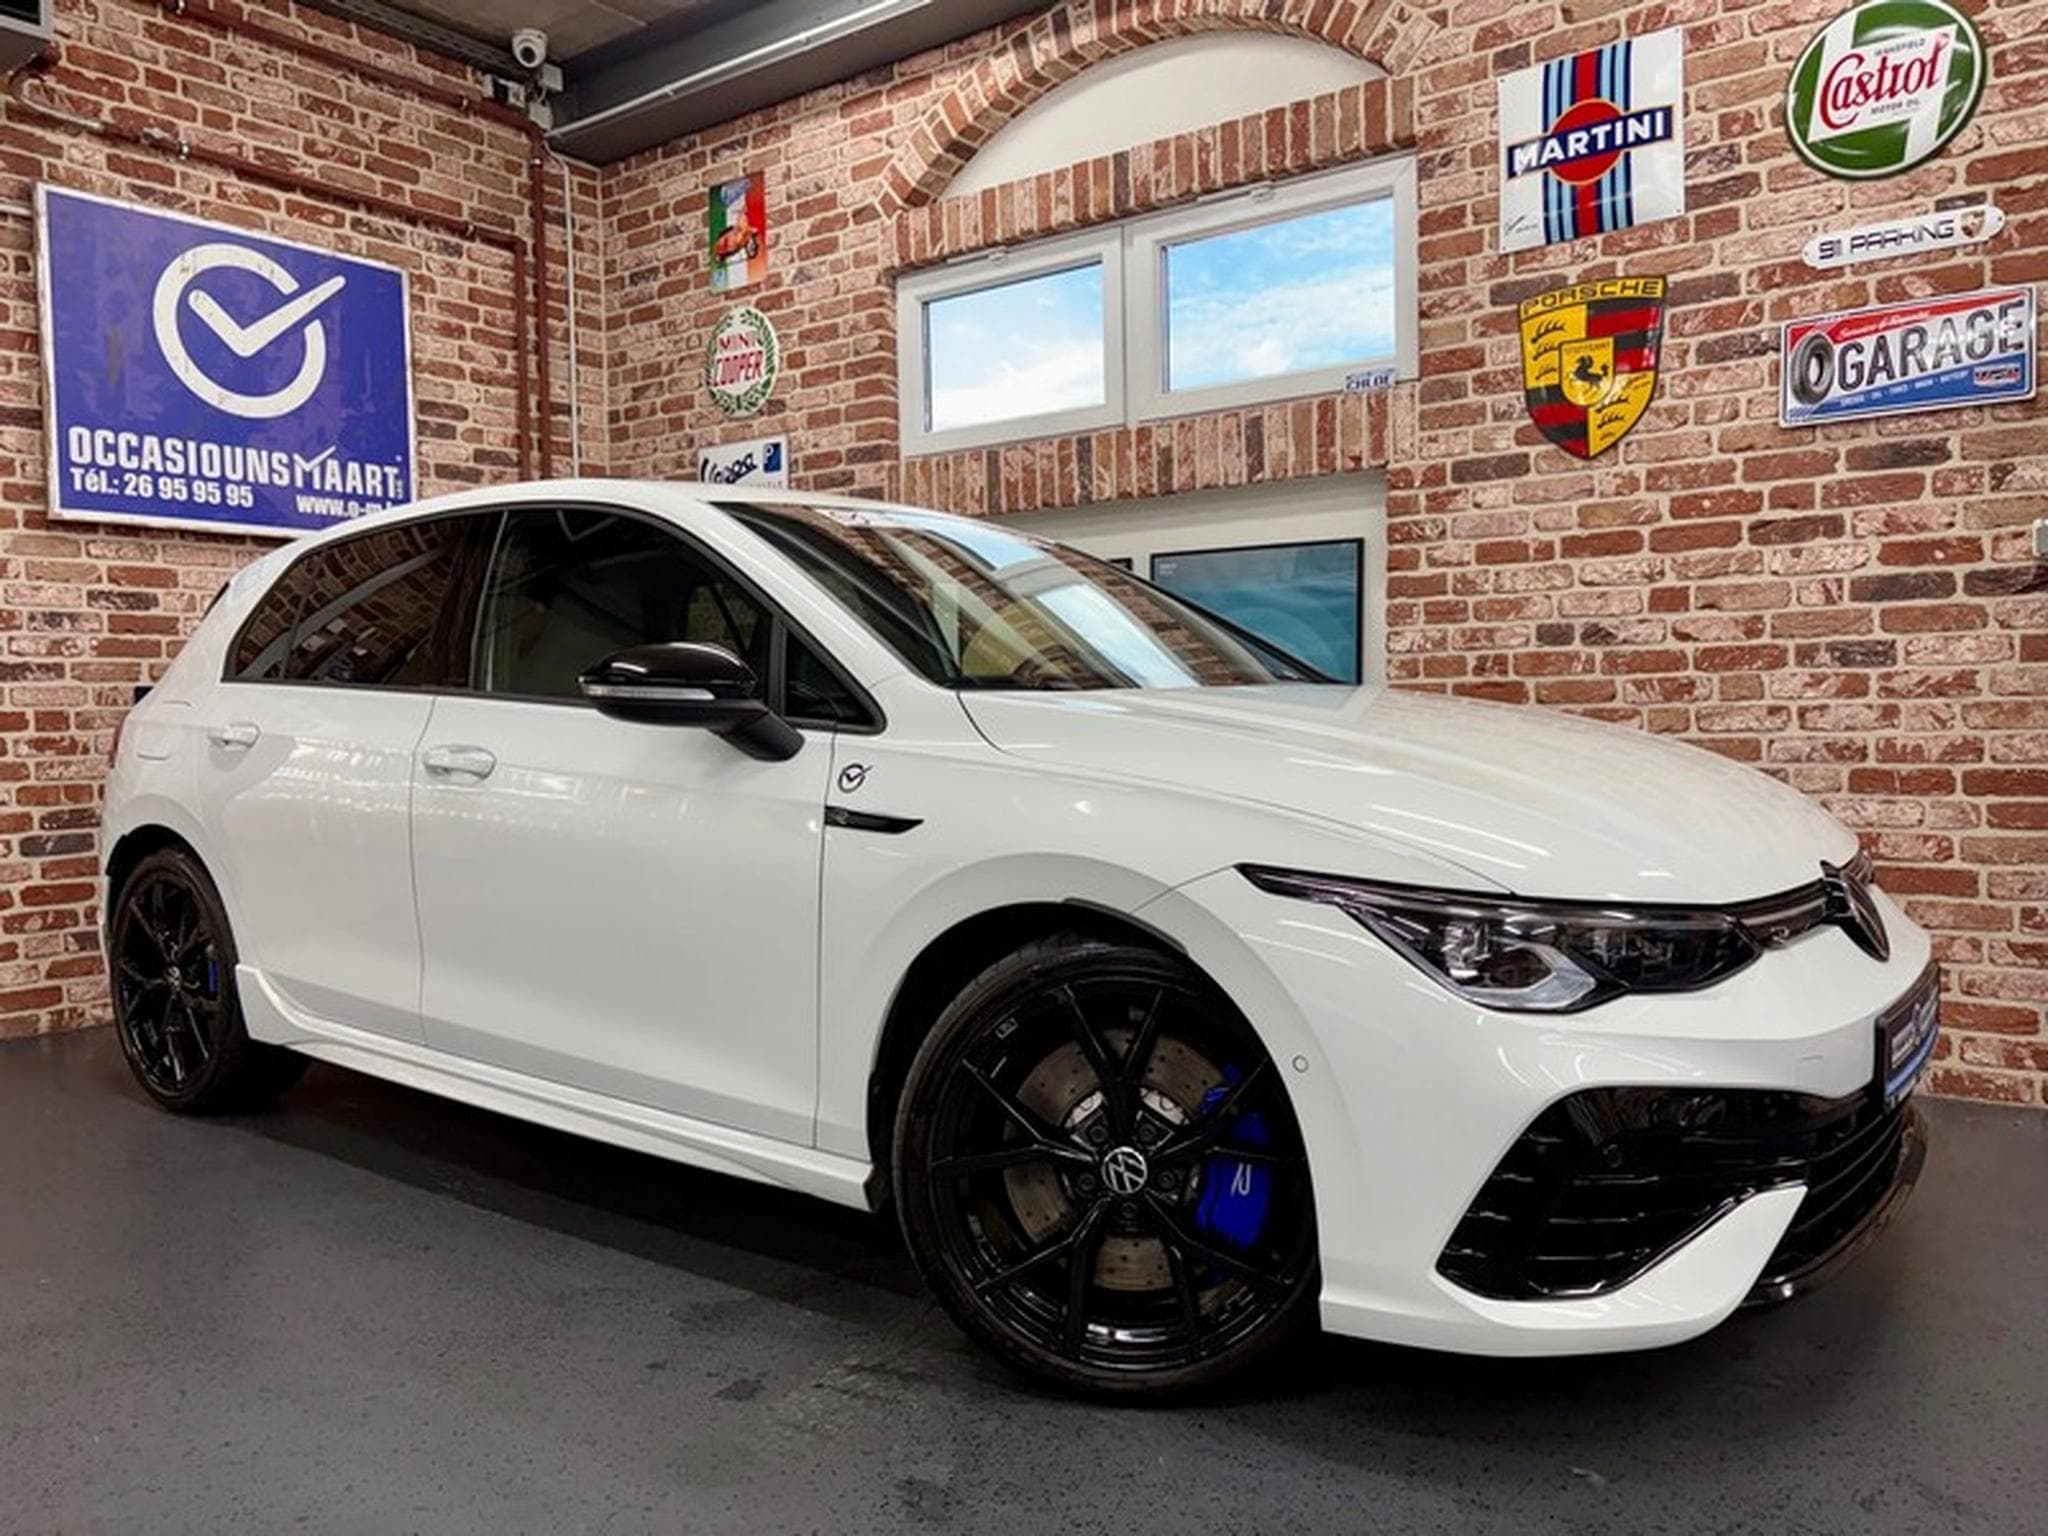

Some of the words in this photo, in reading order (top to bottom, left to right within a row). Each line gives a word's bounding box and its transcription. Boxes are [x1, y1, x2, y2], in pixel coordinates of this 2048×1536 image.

[1819, 33, 1950, 130] Castrol
[1871, 101, 1903, 114] MOTOR
[1511, 111, 1664, 177] MARTINI
[1850, 219, 1955, 254] PARKING
[1523, 281, 1660, 316] PORSCHE
[1839, 300, 2025, 392] GARAGE
[713, 350, 763, 387] COOPER
[124, 472, 152, 498] 26
[158, 476, 188, 502] 95
[193, 480, 221, 505] 95
[226, 483, 254, 508] 95
